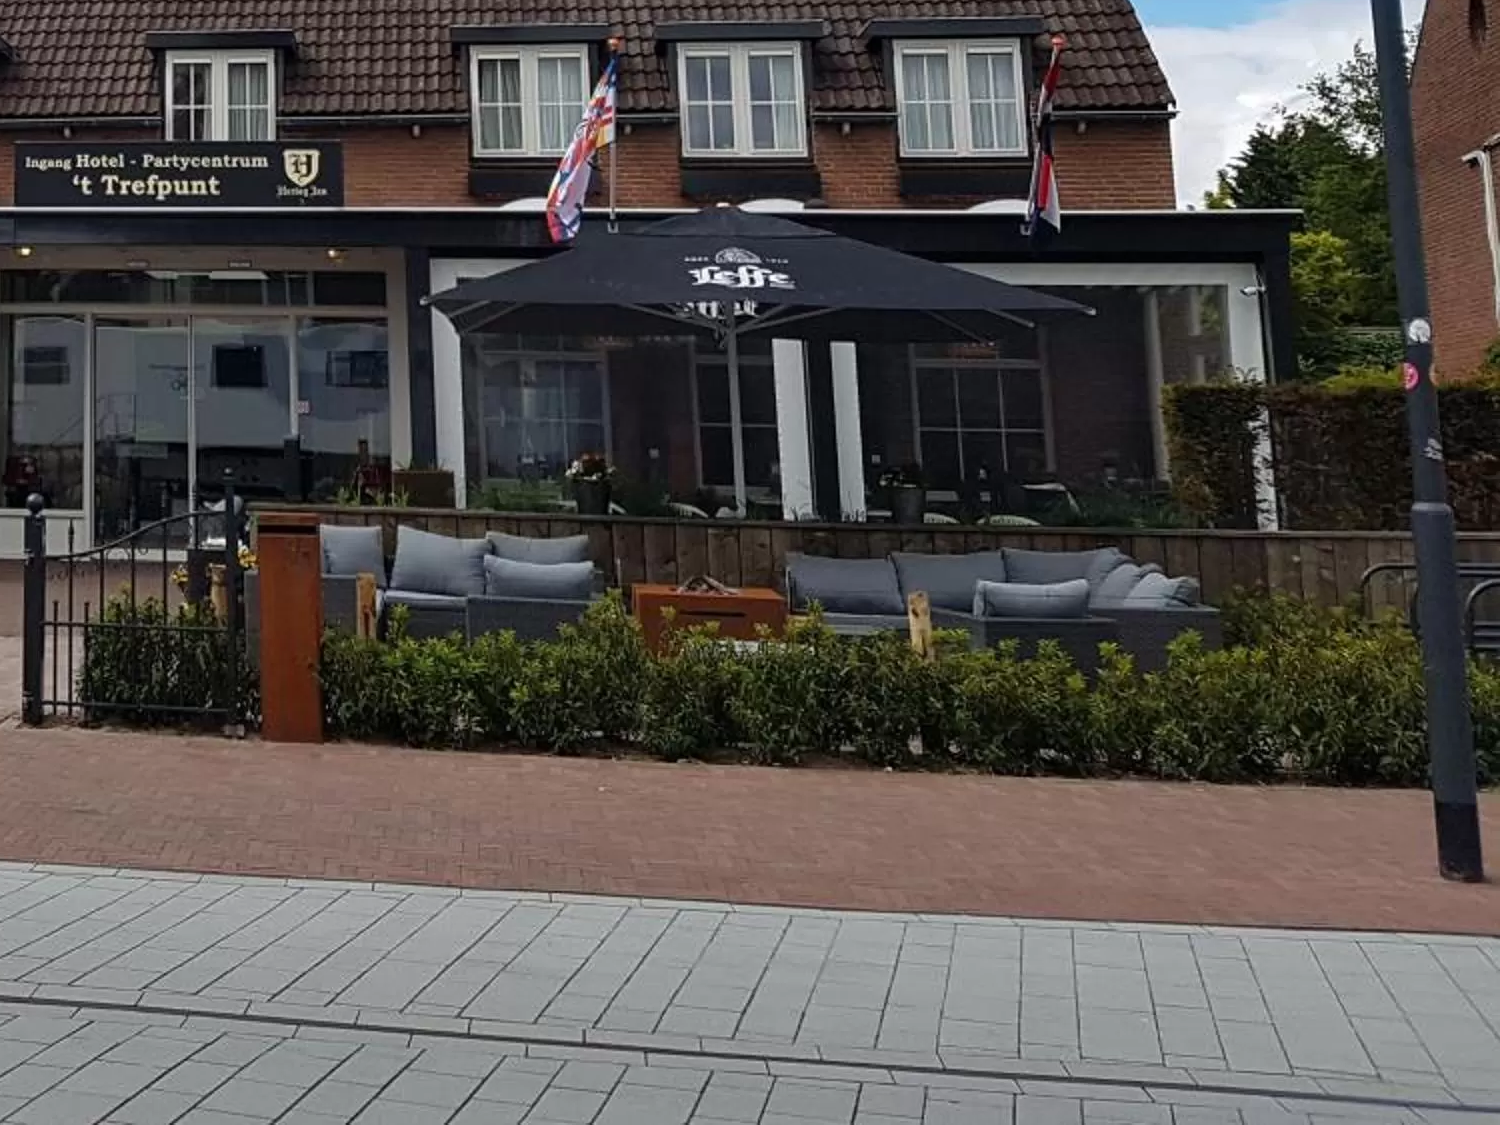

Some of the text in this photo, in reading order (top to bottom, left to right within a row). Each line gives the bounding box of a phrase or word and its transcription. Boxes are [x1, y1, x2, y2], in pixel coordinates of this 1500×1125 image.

[25, 156, 71, 171] Ingang
[75, 154, 124, 168] Hotel
[143, 154, 268, 172] Partycentrum
[101, 175, 220, 200] Trefpunt
[688, 264, 796, 289] Leffe
